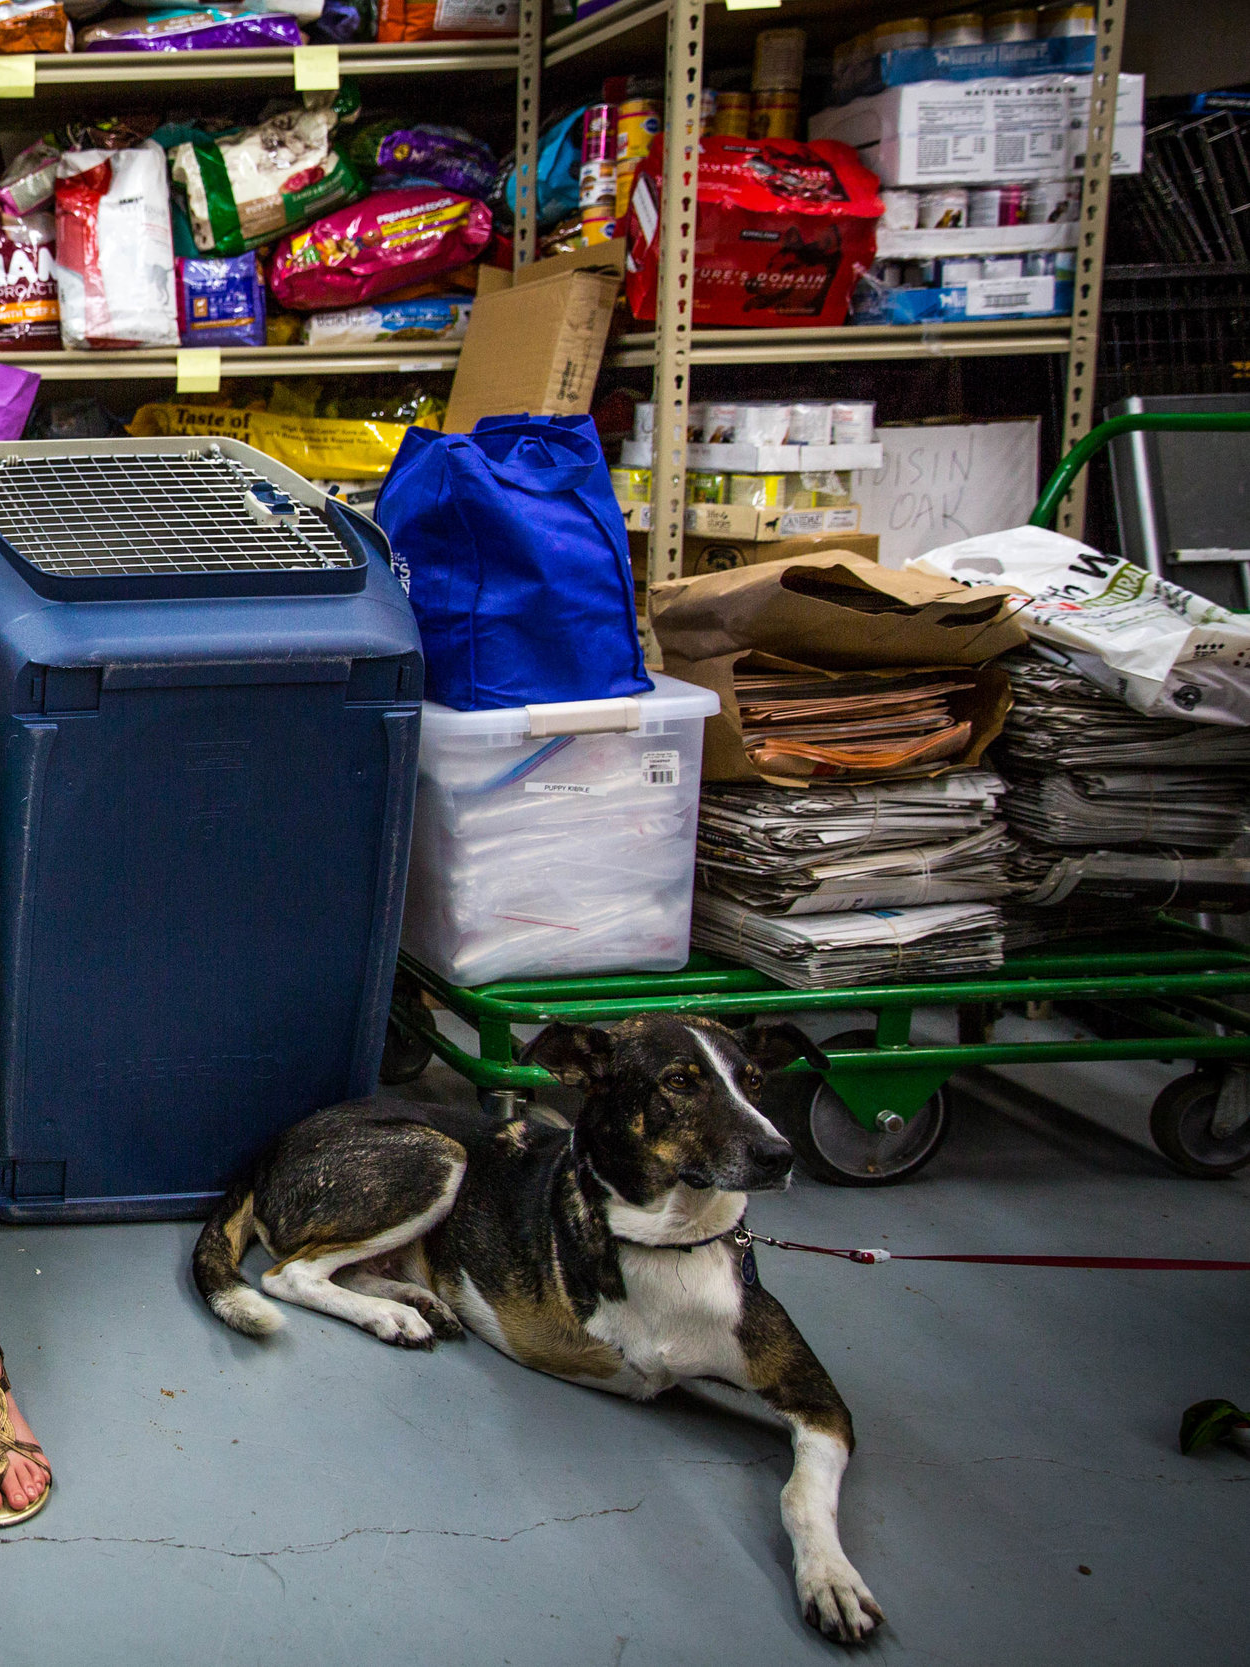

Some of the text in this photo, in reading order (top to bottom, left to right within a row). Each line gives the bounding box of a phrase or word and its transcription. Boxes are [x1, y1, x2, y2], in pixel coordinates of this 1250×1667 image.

[757, 272, 827, 283] DOMAIN
[177, 408, 252, 429] Taste of
[889, 485, 972, 538] OAK
[544, 784, 567, 792] PUPPY
